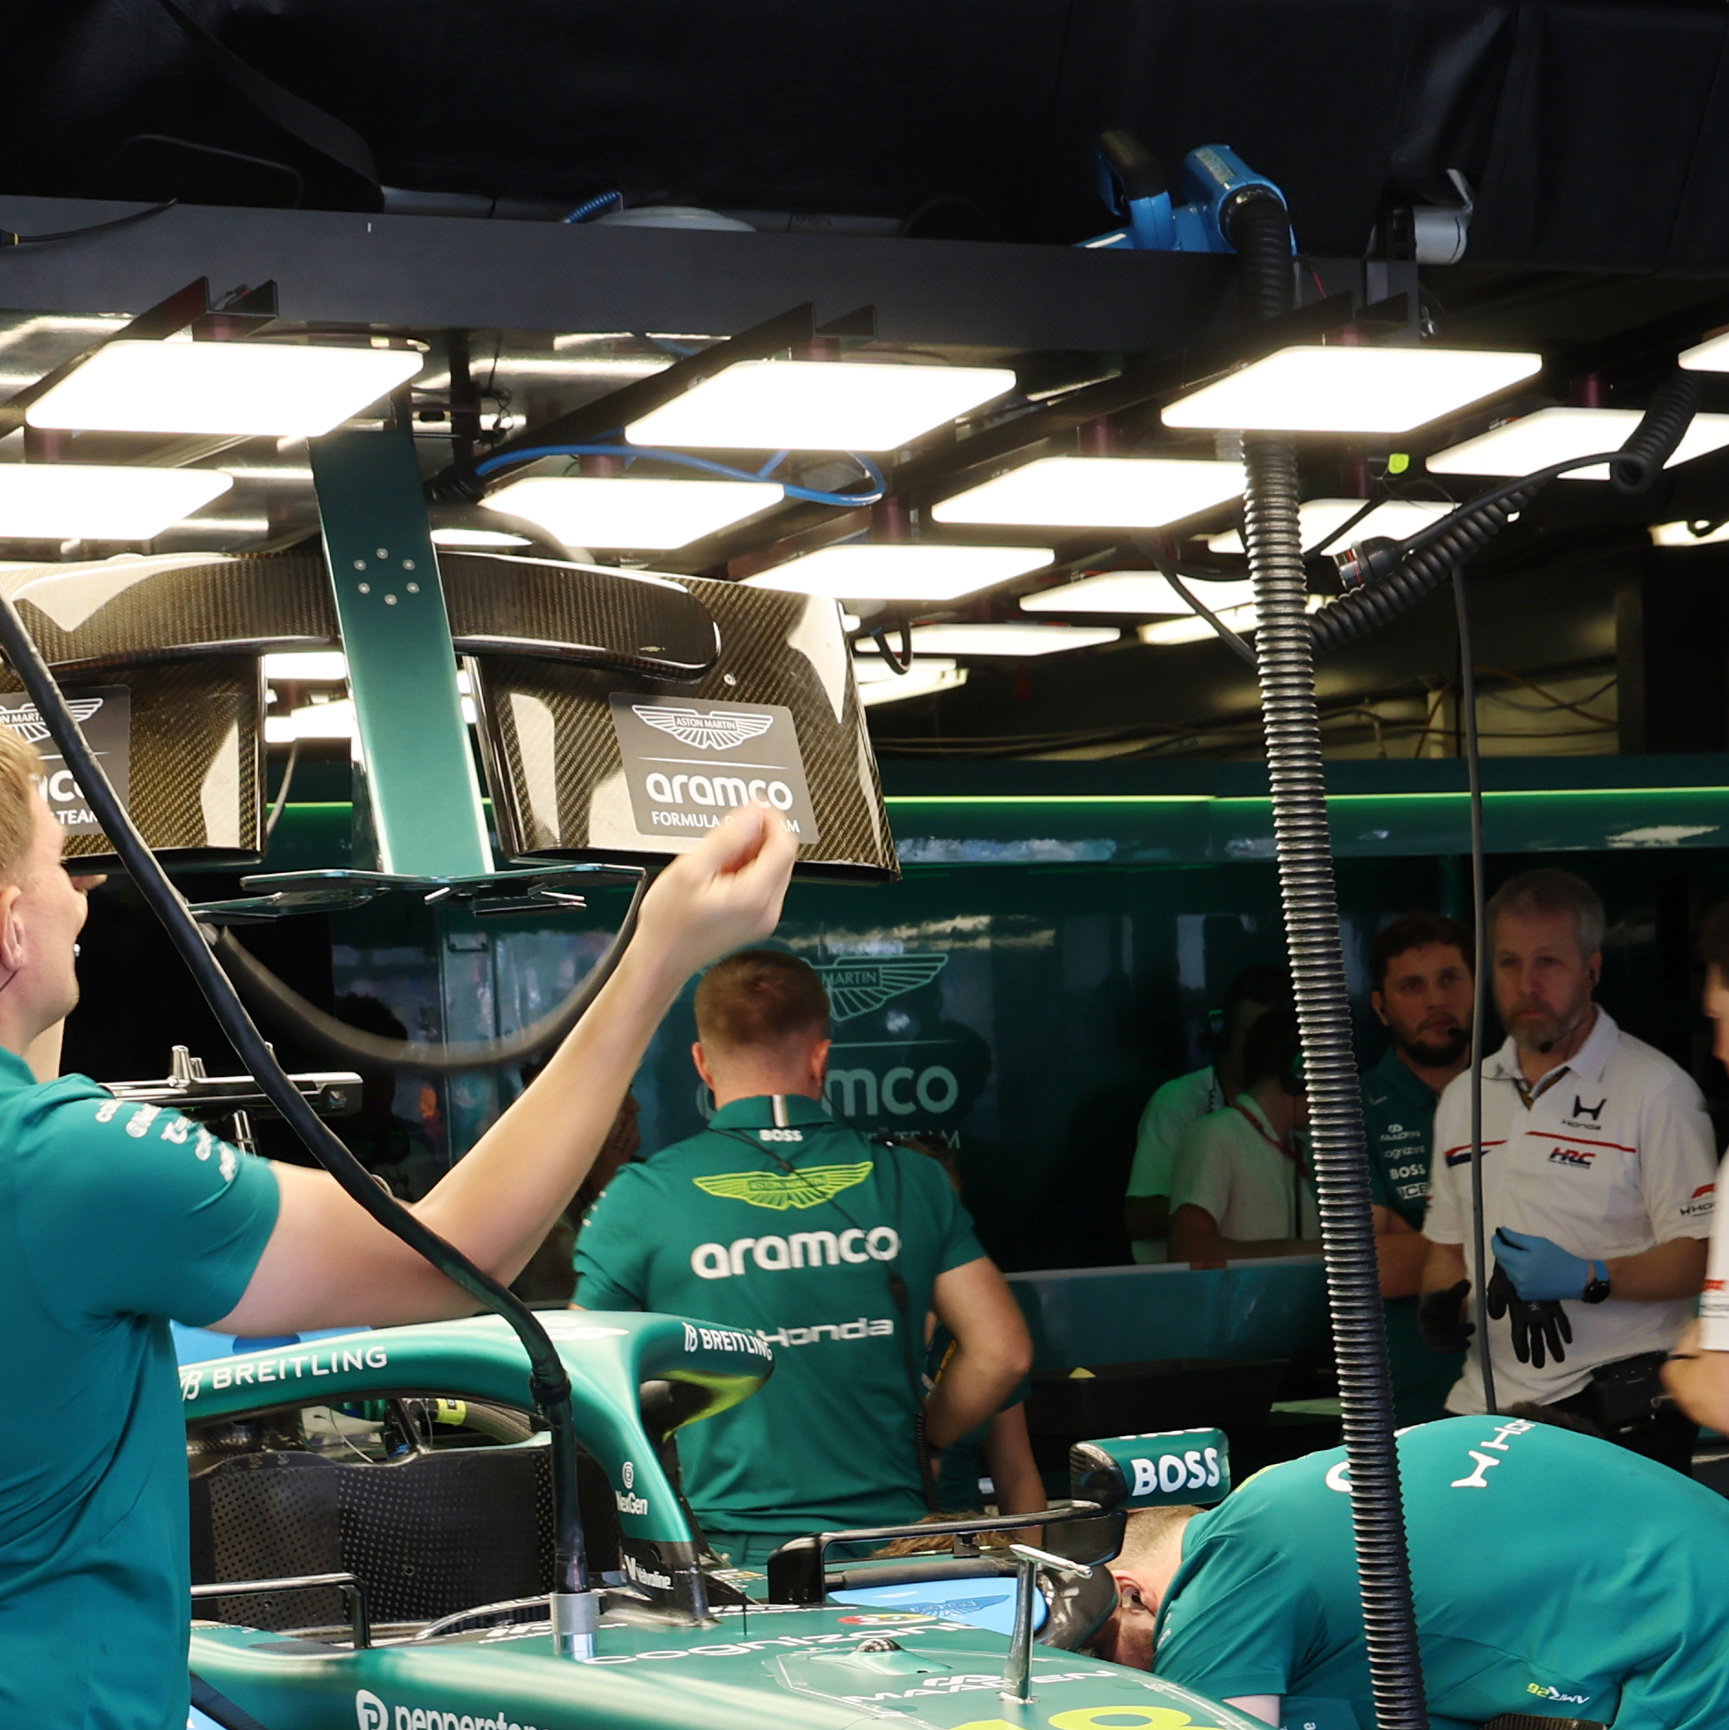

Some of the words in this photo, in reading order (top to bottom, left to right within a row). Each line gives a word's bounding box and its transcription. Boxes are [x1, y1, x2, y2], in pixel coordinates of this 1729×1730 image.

[675, 716, 703, 729] ASTON
[704, 718, 736, 731] MARTIN
[651, 811, 721, 829] FORMULA
[759, 1129, 804, 1143] BOSS
[1548, 1147, 1596, 1167] HRC
[1389, 1165, 1427, 1180] BOSS
[690, 1226, 902, 1280] aramco
[700, 1328, 773, 1361] BREITLING
[212, 1345, 388, 1391] BREITLING
[1130, 1446, 1221, 1497] BOSS
[614, 1490, 649, 1516] NexGen
